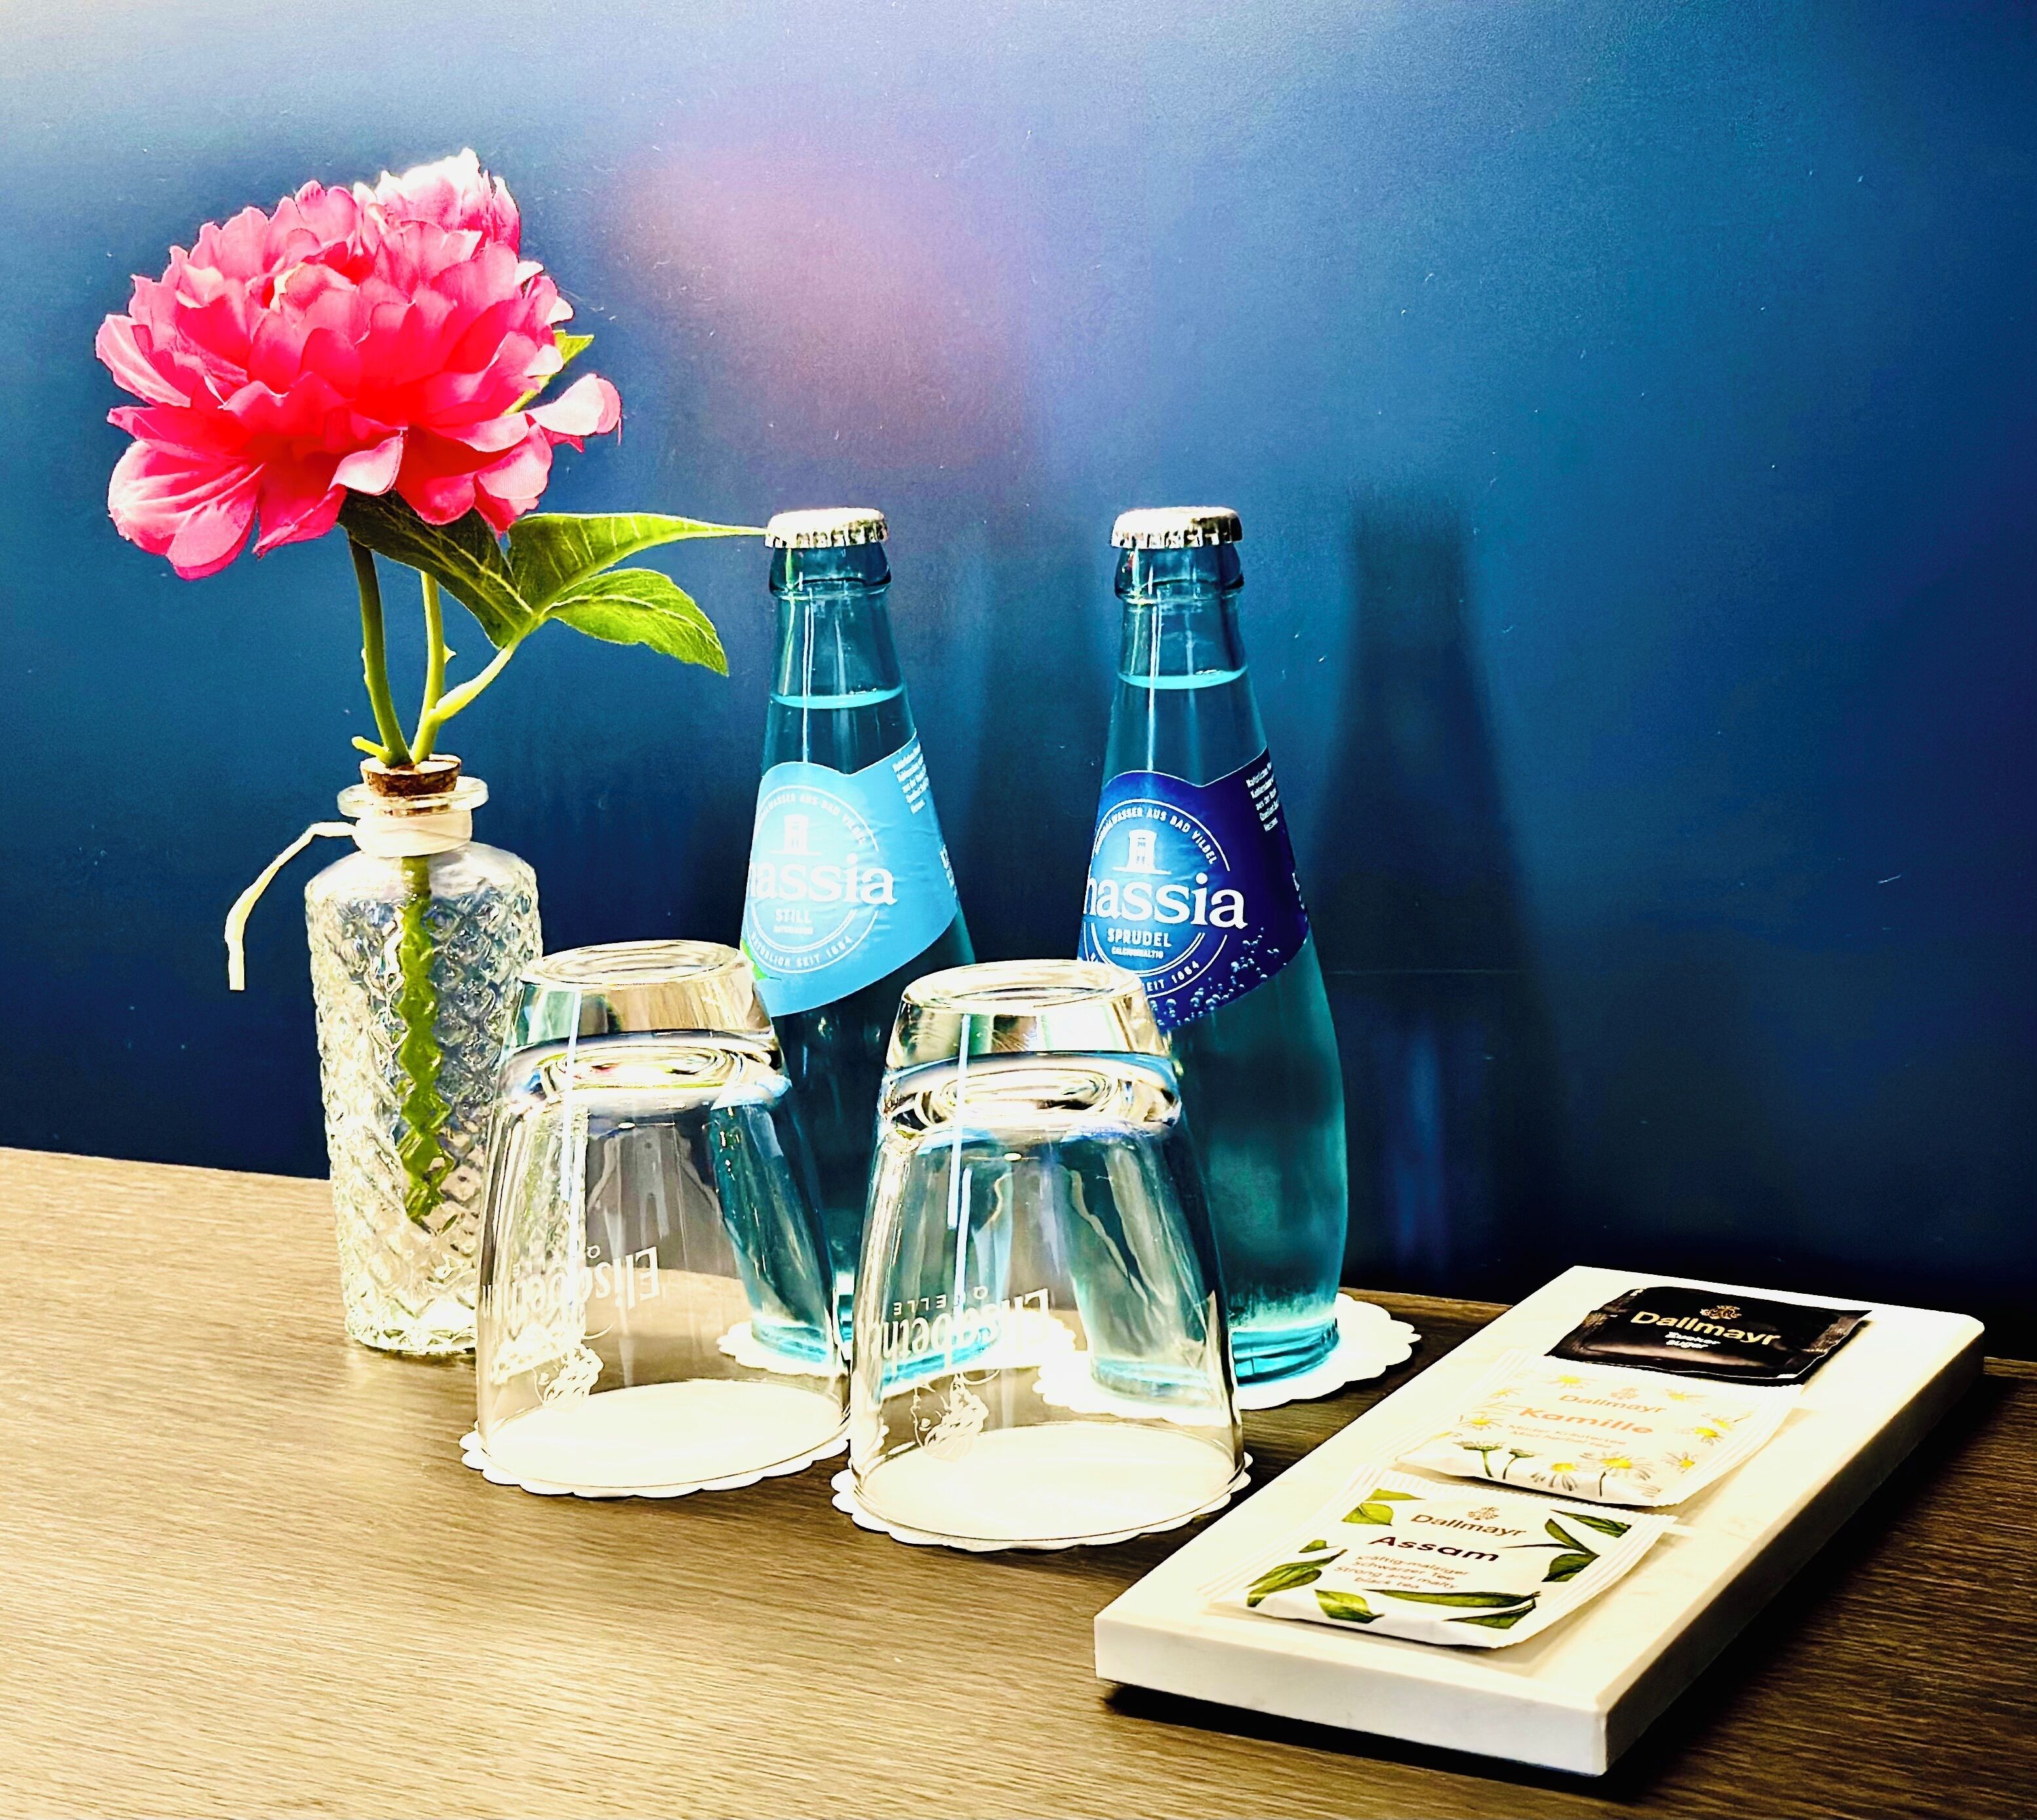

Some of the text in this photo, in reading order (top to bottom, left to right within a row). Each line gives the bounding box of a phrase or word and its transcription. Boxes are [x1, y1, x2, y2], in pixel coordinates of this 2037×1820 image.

[1146, 807, 1167, 821] AUS
[1169, 815, 1191, 833] BAD
[1191, 830, 1217, 865] VILBEL
[775, 908, 812, 923] STILL
[1107, 927, 1172, 948] SPRUDEL
[1143, 978, 1165, 992] EIT
[1630, 1311, 1782, 1346] Dallmayr
[1559, 1395, 1667, 1413] Dallmayr
[1519, 1407, 1653, 1434] Kamille
[1410, 1514, 1528, 1537] Dallmayr
[1367, 1536, 1500, 1561] Assam
[1334, 1566, 1382, 1578] Strong
[1416, 1578, 1459, 1590] malty
[1353, 1577, 1391, 1586] black
